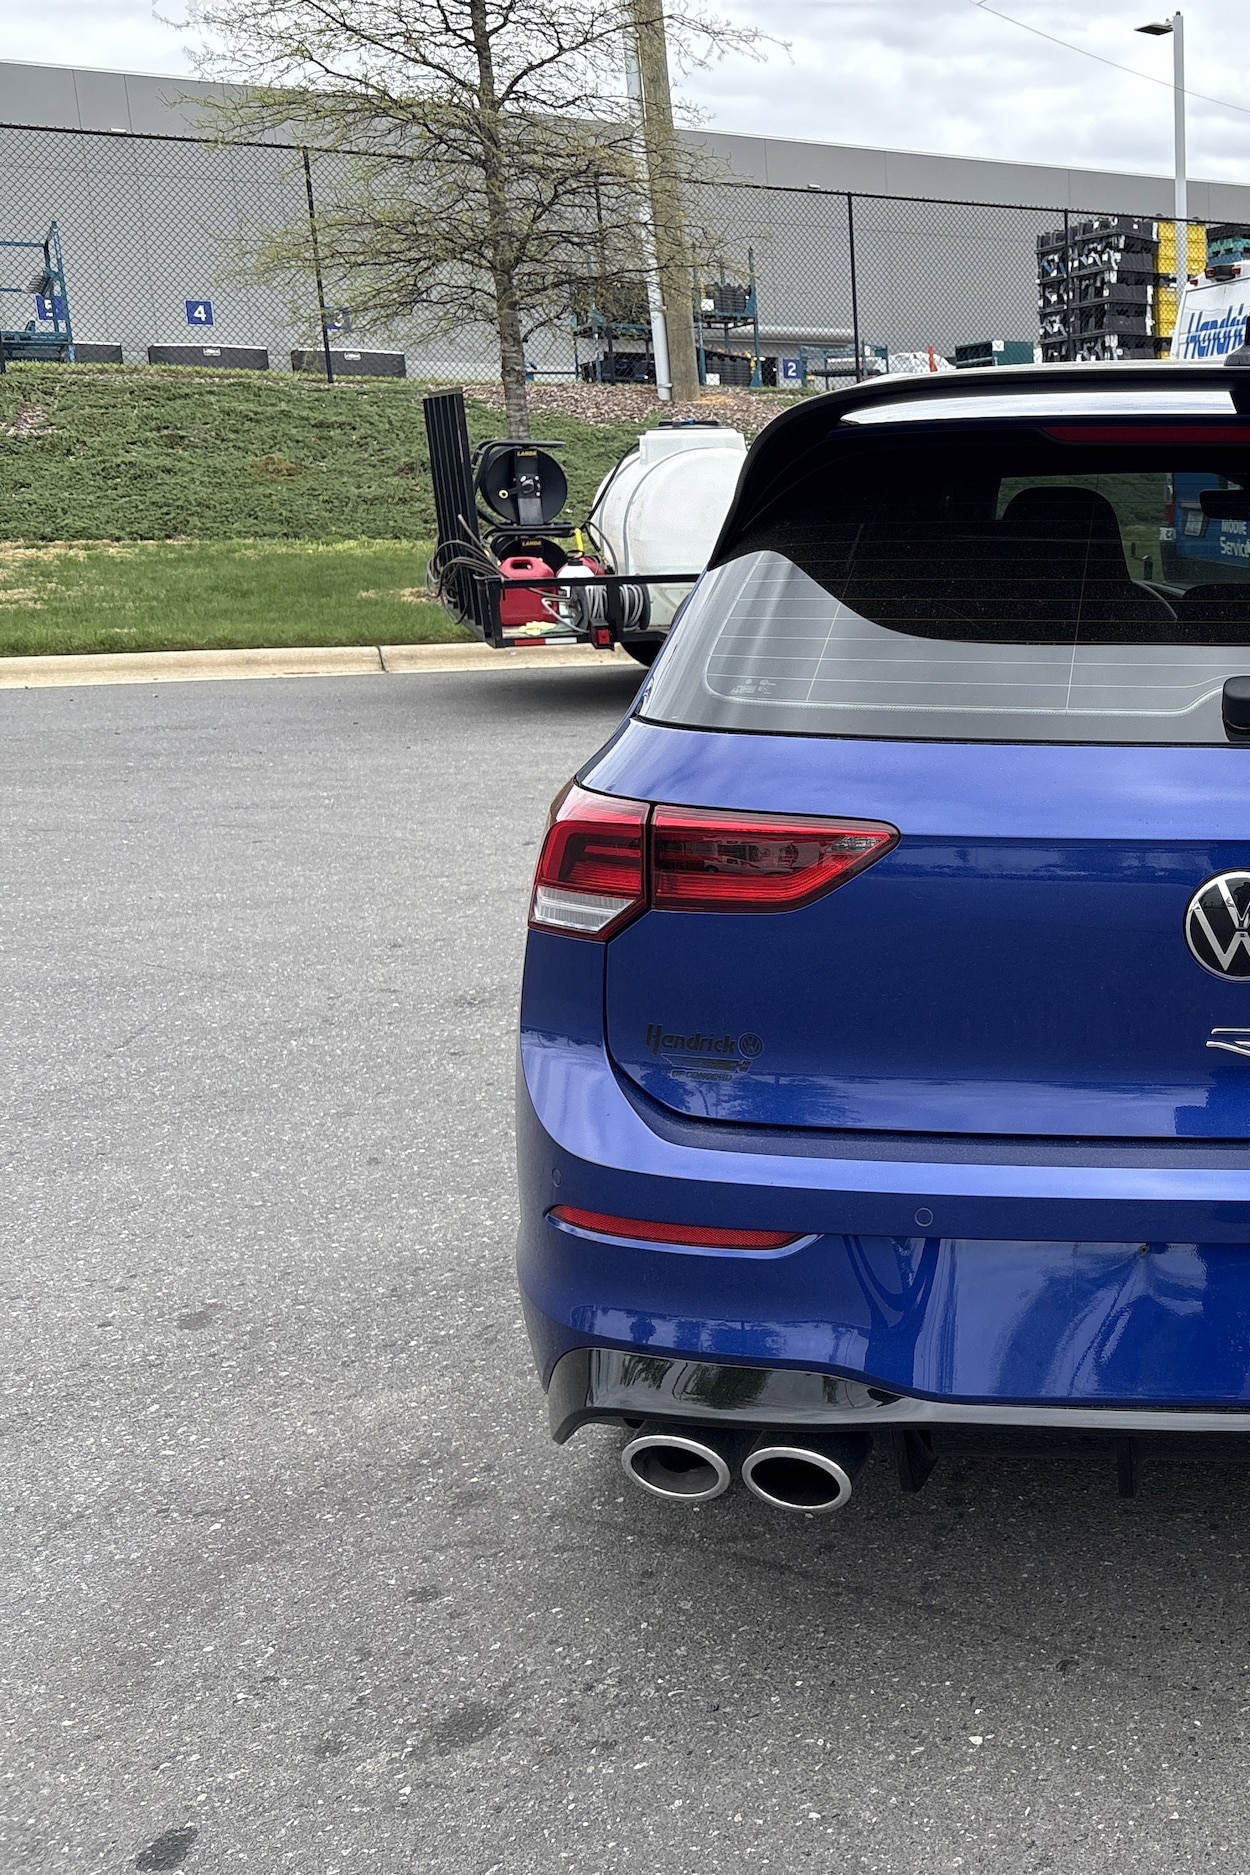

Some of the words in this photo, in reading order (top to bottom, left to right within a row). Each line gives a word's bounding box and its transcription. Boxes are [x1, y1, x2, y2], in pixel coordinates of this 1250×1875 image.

[193, 304, 207, 321] 4
[787, 361, 797, 377] 2
[1219, 536, 1250, 558] Service
[645, 1023, 735, 1055] Hendrick
